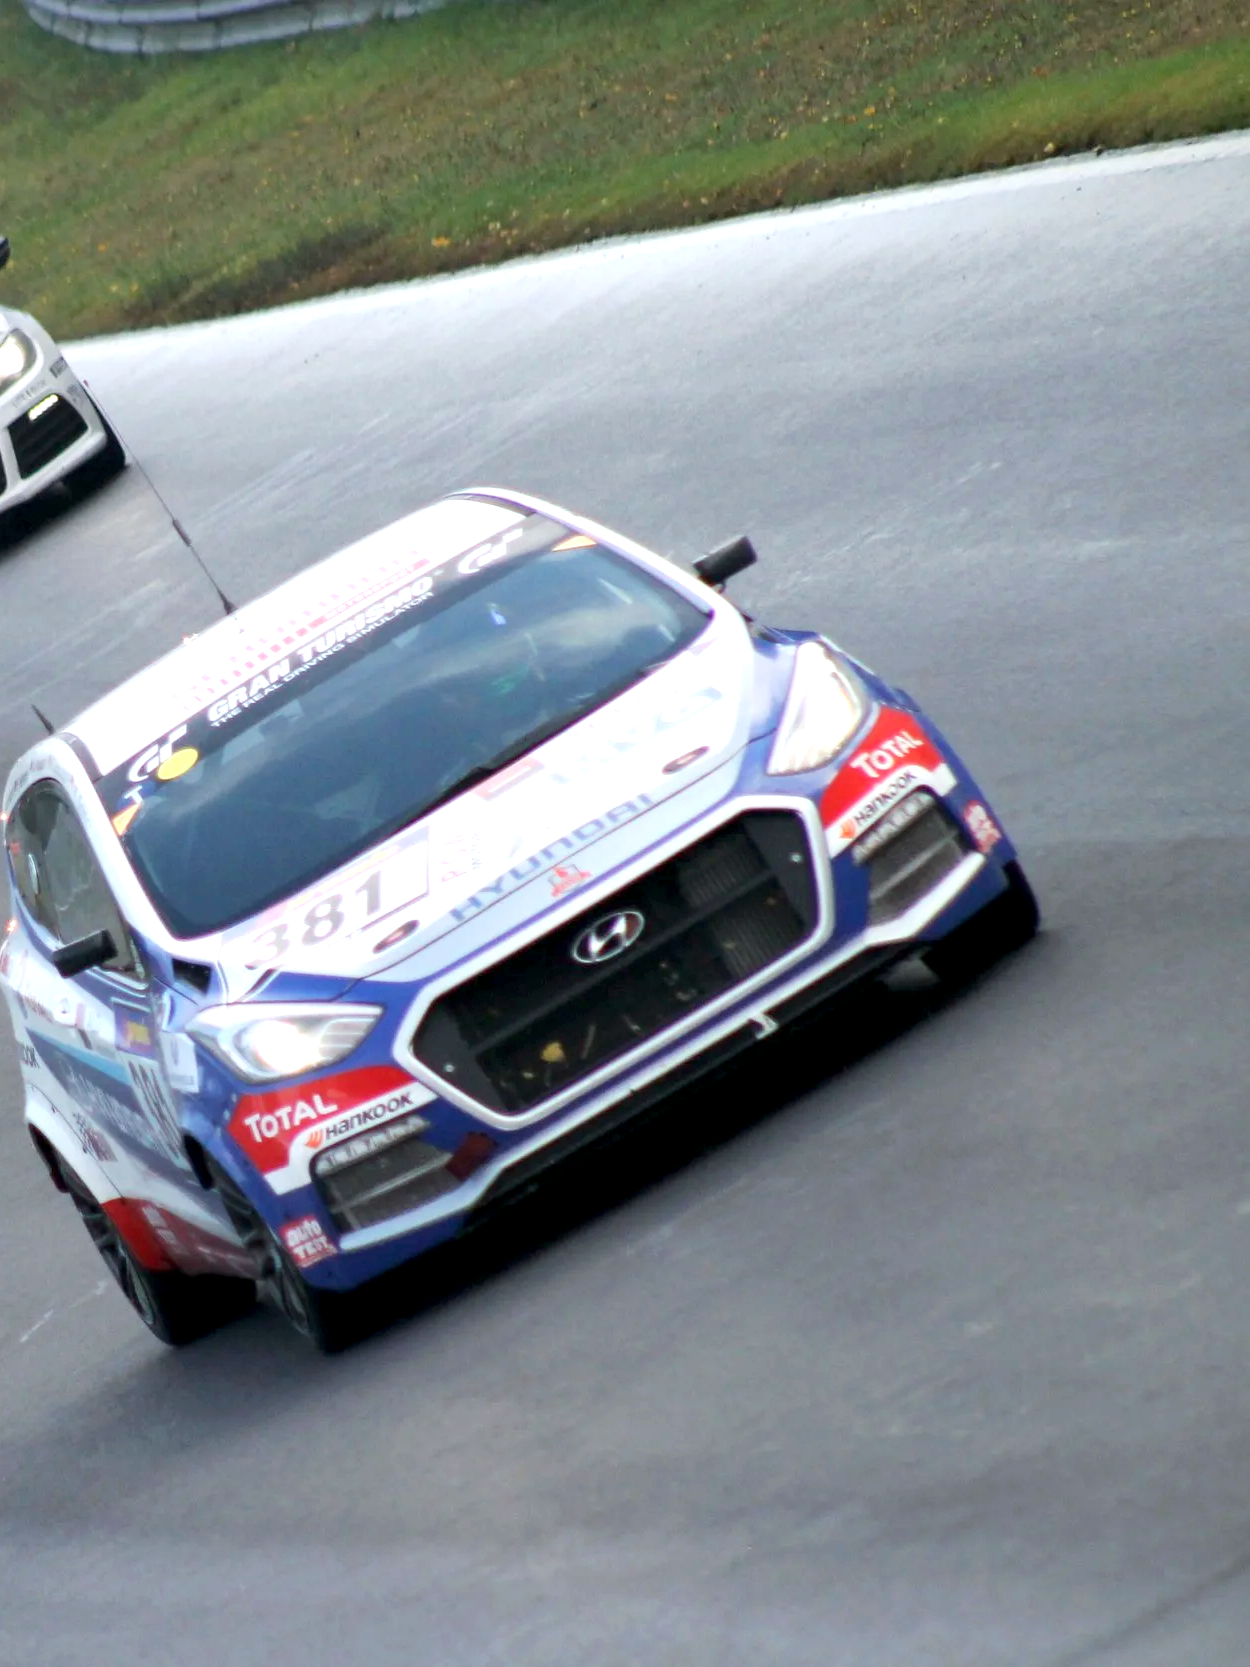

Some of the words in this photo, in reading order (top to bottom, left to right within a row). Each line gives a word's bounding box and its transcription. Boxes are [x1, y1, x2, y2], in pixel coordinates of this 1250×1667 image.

[324, 565, 414, 620] MOTORSPORT
[208, 658, 291, 722] GRAN
[296, 576, 433, 662] TURISMO
[210, 706, 242, 727] THE
[242, 682, 284, 708] REAL
[283, 643, 345, 682] DRIVING
[346, 590, 434, 643] SIMULATOR
[851, 729, 925, 778] TOTAL
[245, 869, 382, 971] 381
[244, 1094, 339, 1143] TOTAL
